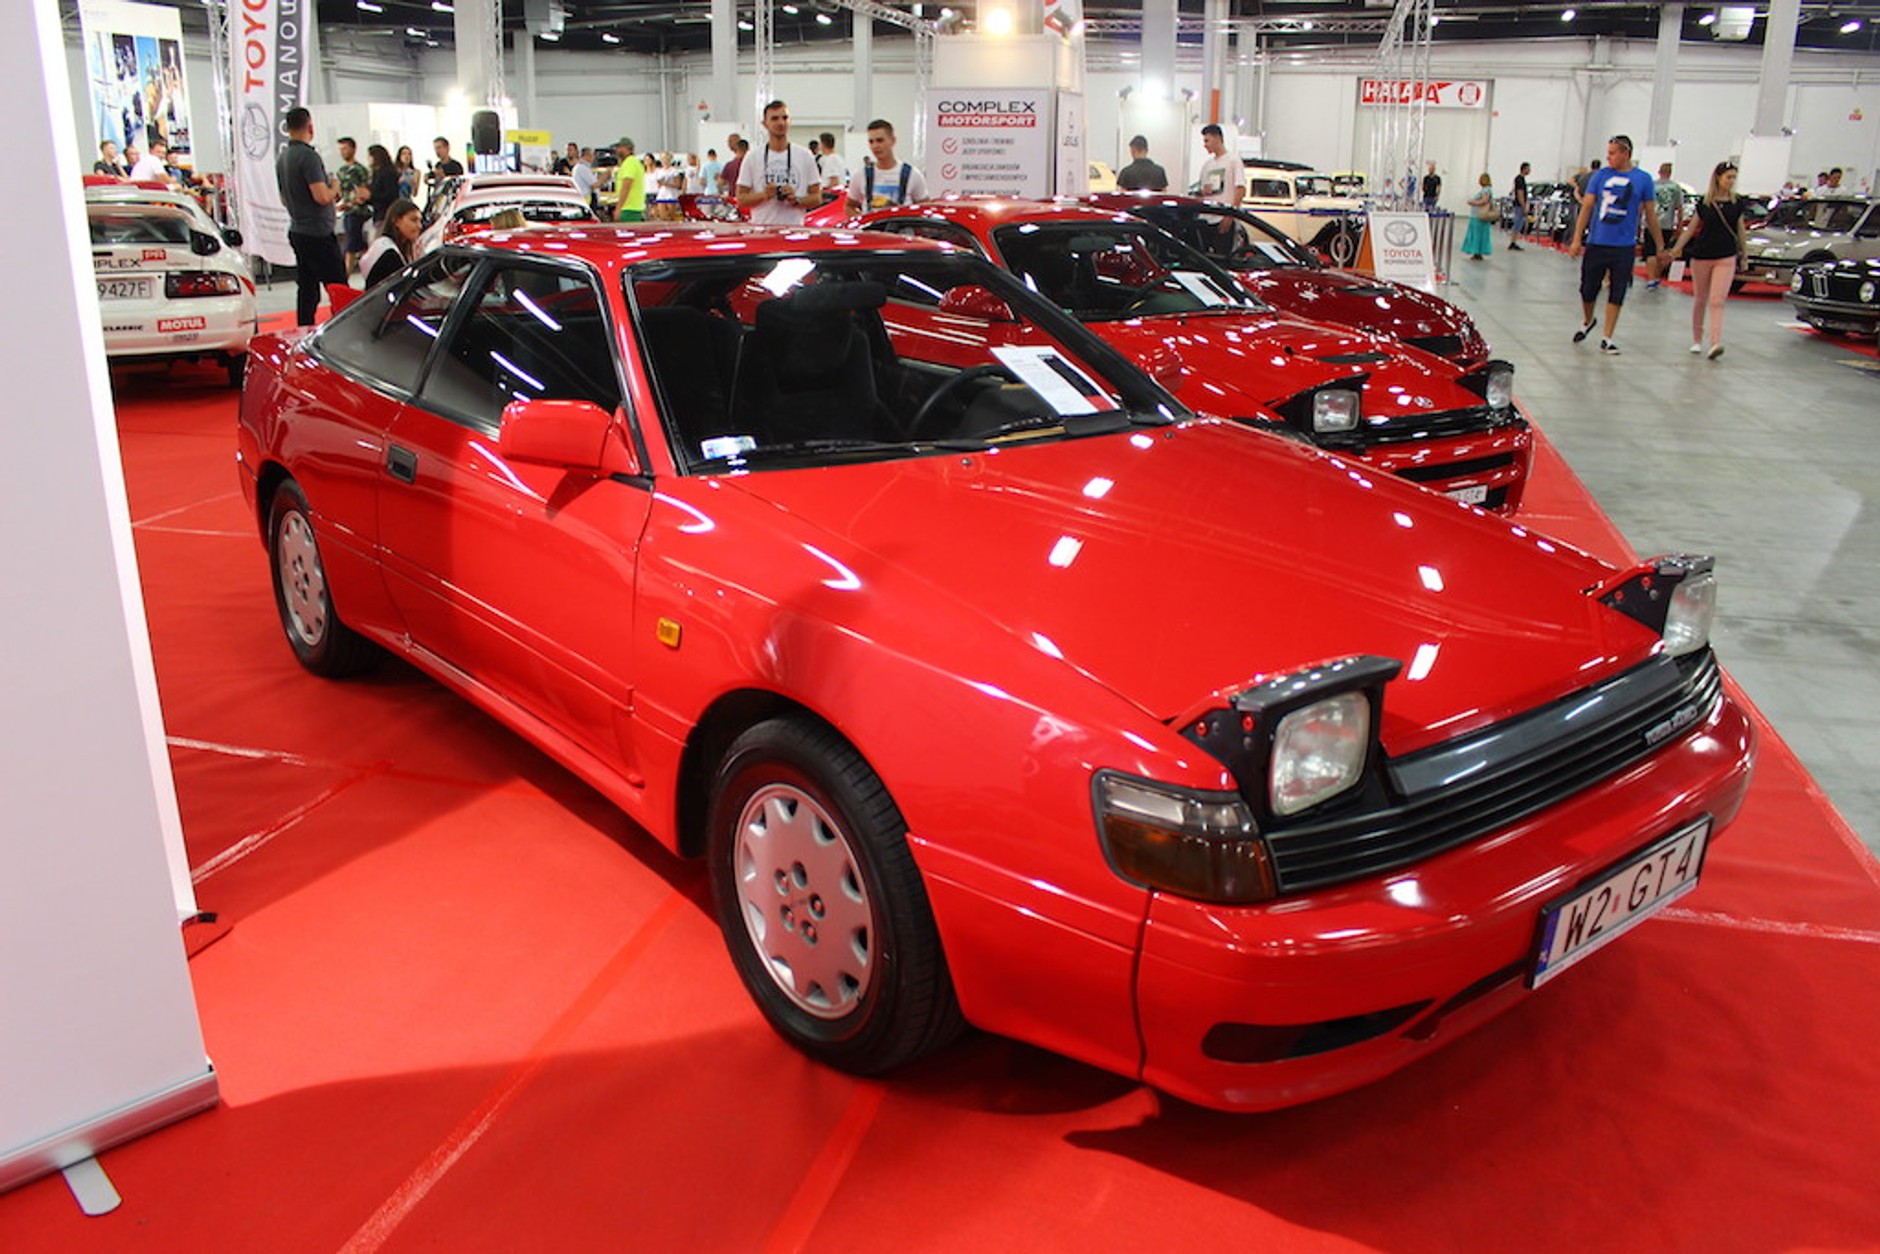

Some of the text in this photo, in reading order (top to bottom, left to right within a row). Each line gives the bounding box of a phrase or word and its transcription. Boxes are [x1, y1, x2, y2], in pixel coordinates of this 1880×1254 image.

[938, 101, 1035, 113] COMPLEX
[941, 116, 1035, 126] MOTORSPORT
[1384, 249, 1423, 258] TOYOTA
[160, 318, 204, 331] MOTUL
[1564, 836, 1696, 953] W2 GT4
